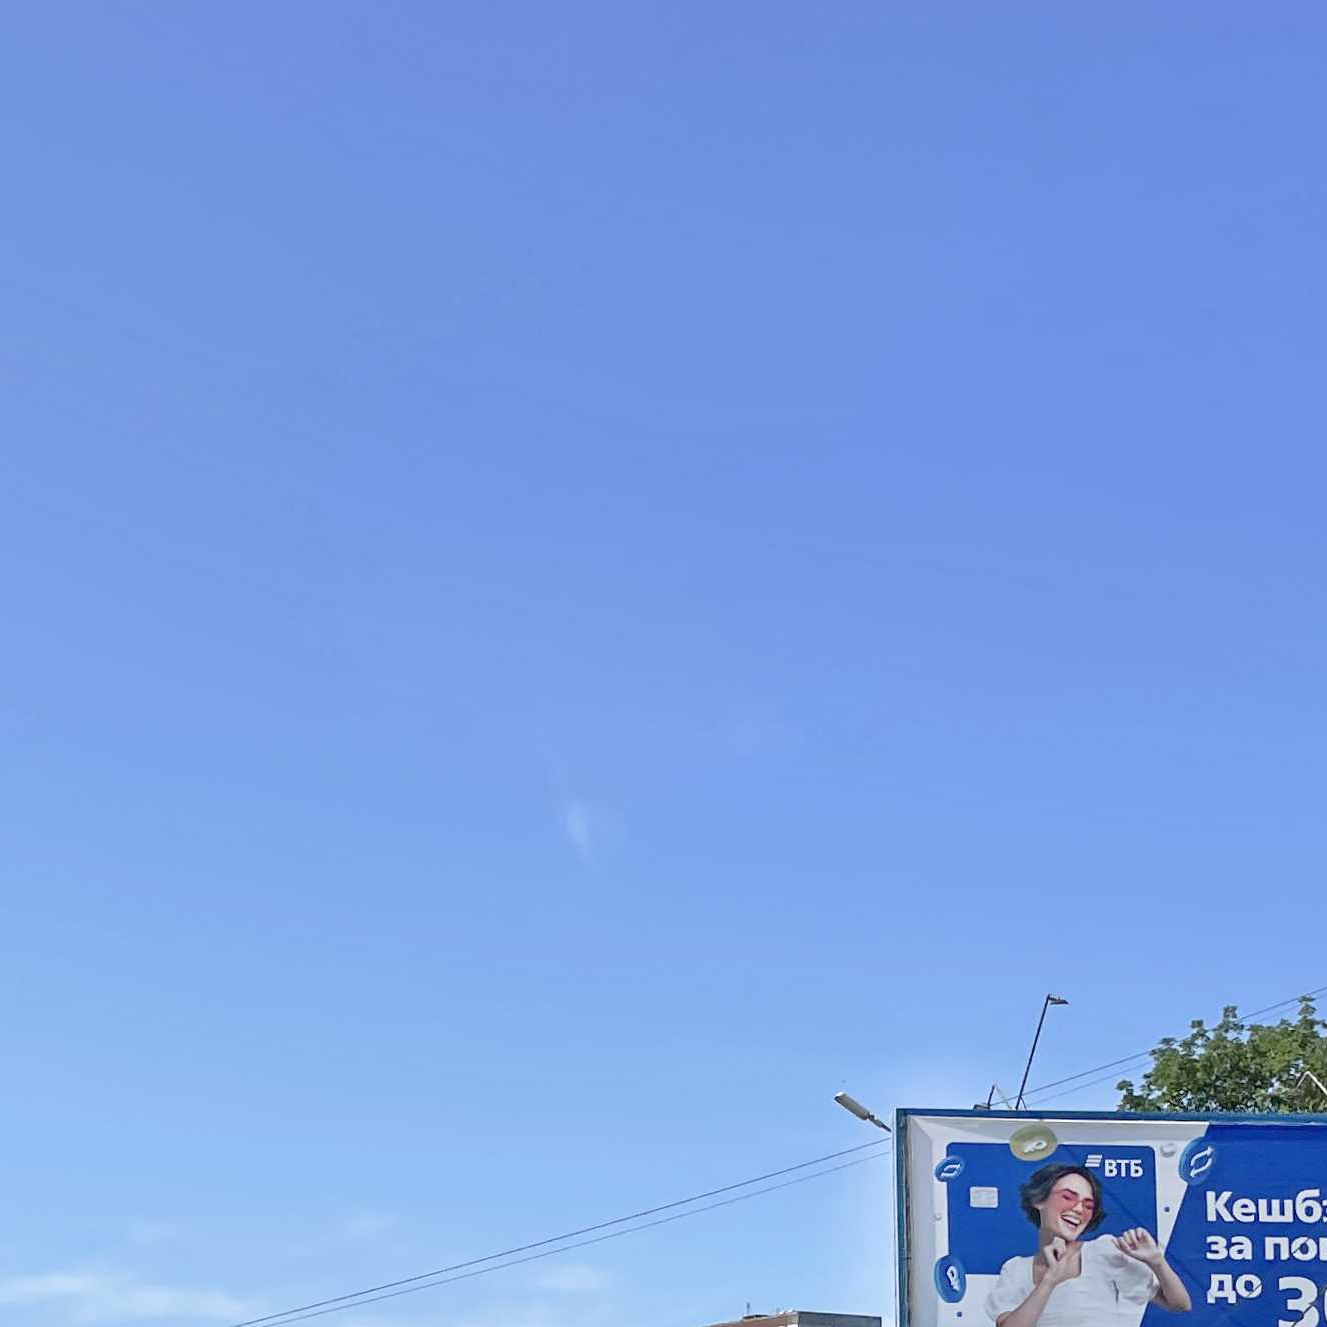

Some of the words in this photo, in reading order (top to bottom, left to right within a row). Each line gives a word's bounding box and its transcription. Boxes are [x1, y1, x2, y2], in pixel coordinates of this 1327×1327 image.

[1104, 1159, 1143, 1178] ВТБ
[1205, 1235, 1253, 1261] за
[1206, 1273, 1263, 1304] до
